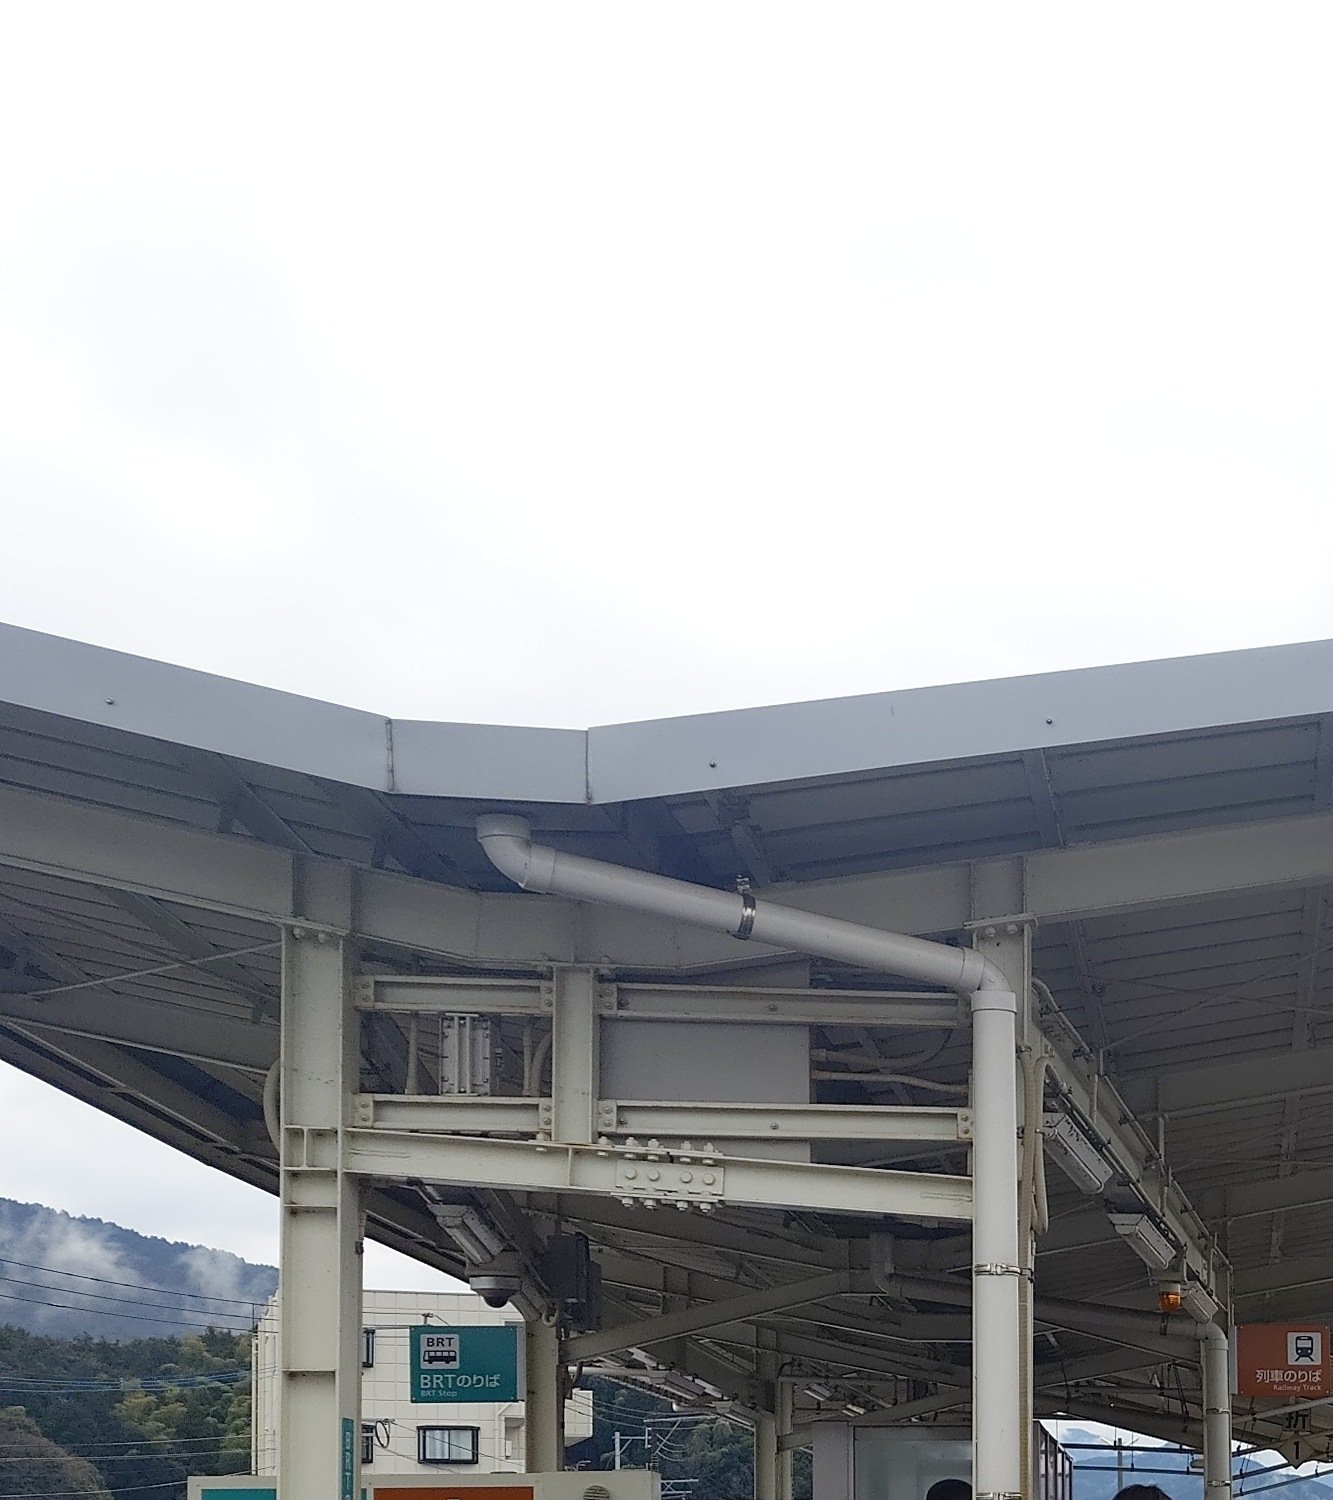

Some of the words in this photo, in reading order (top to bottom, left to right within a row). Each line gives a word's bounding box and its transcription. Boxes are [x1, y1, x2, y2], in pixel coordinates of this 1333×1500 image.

[426, 1337, 454, 1347] BRT
[420, 1374, 500, 1388] BRTのりば
[1255, 1370, 1322, 1383] 列車のりば
